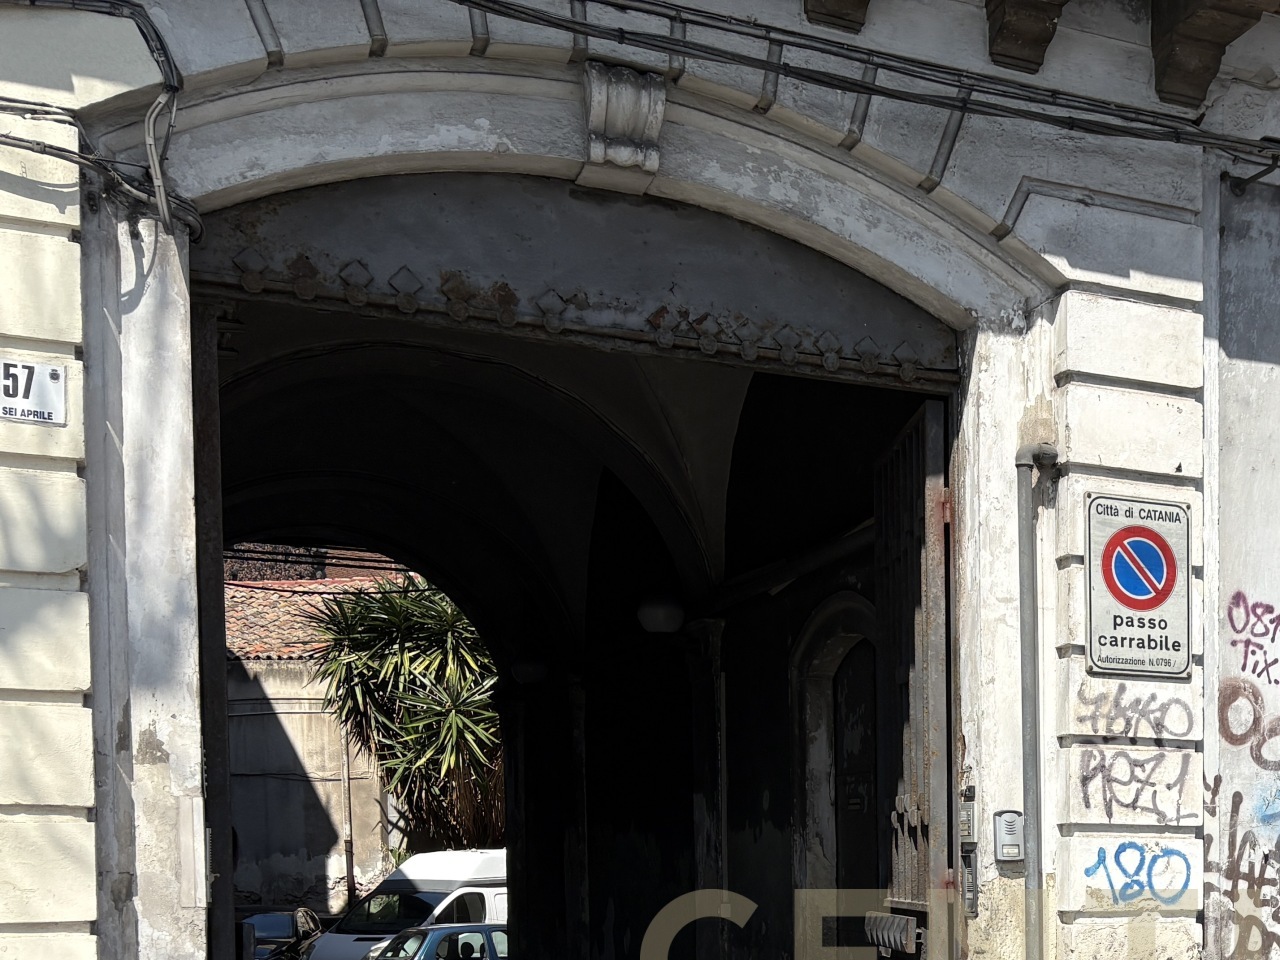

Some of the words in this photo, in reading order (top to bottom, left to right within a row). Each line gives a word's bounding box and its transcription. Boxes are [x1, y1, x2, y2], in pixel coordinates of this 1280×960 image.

[3, 362, 35, 400] 57
[2, 406, 17, 416] SEI
[20, 409, 54, 421] APRILE
[1096, 503, 1119, 517] Città
[1125, 506, 1134, 519] di
[1139, 508, 1182, 524] CATANIA
[1113, 614, 1168, 630] passo
[1098, 634, 1182, 652] carrabile
[1097, 654, 1146, 666] Autorizzazione
[1084, 841, 1192, 906] 180
